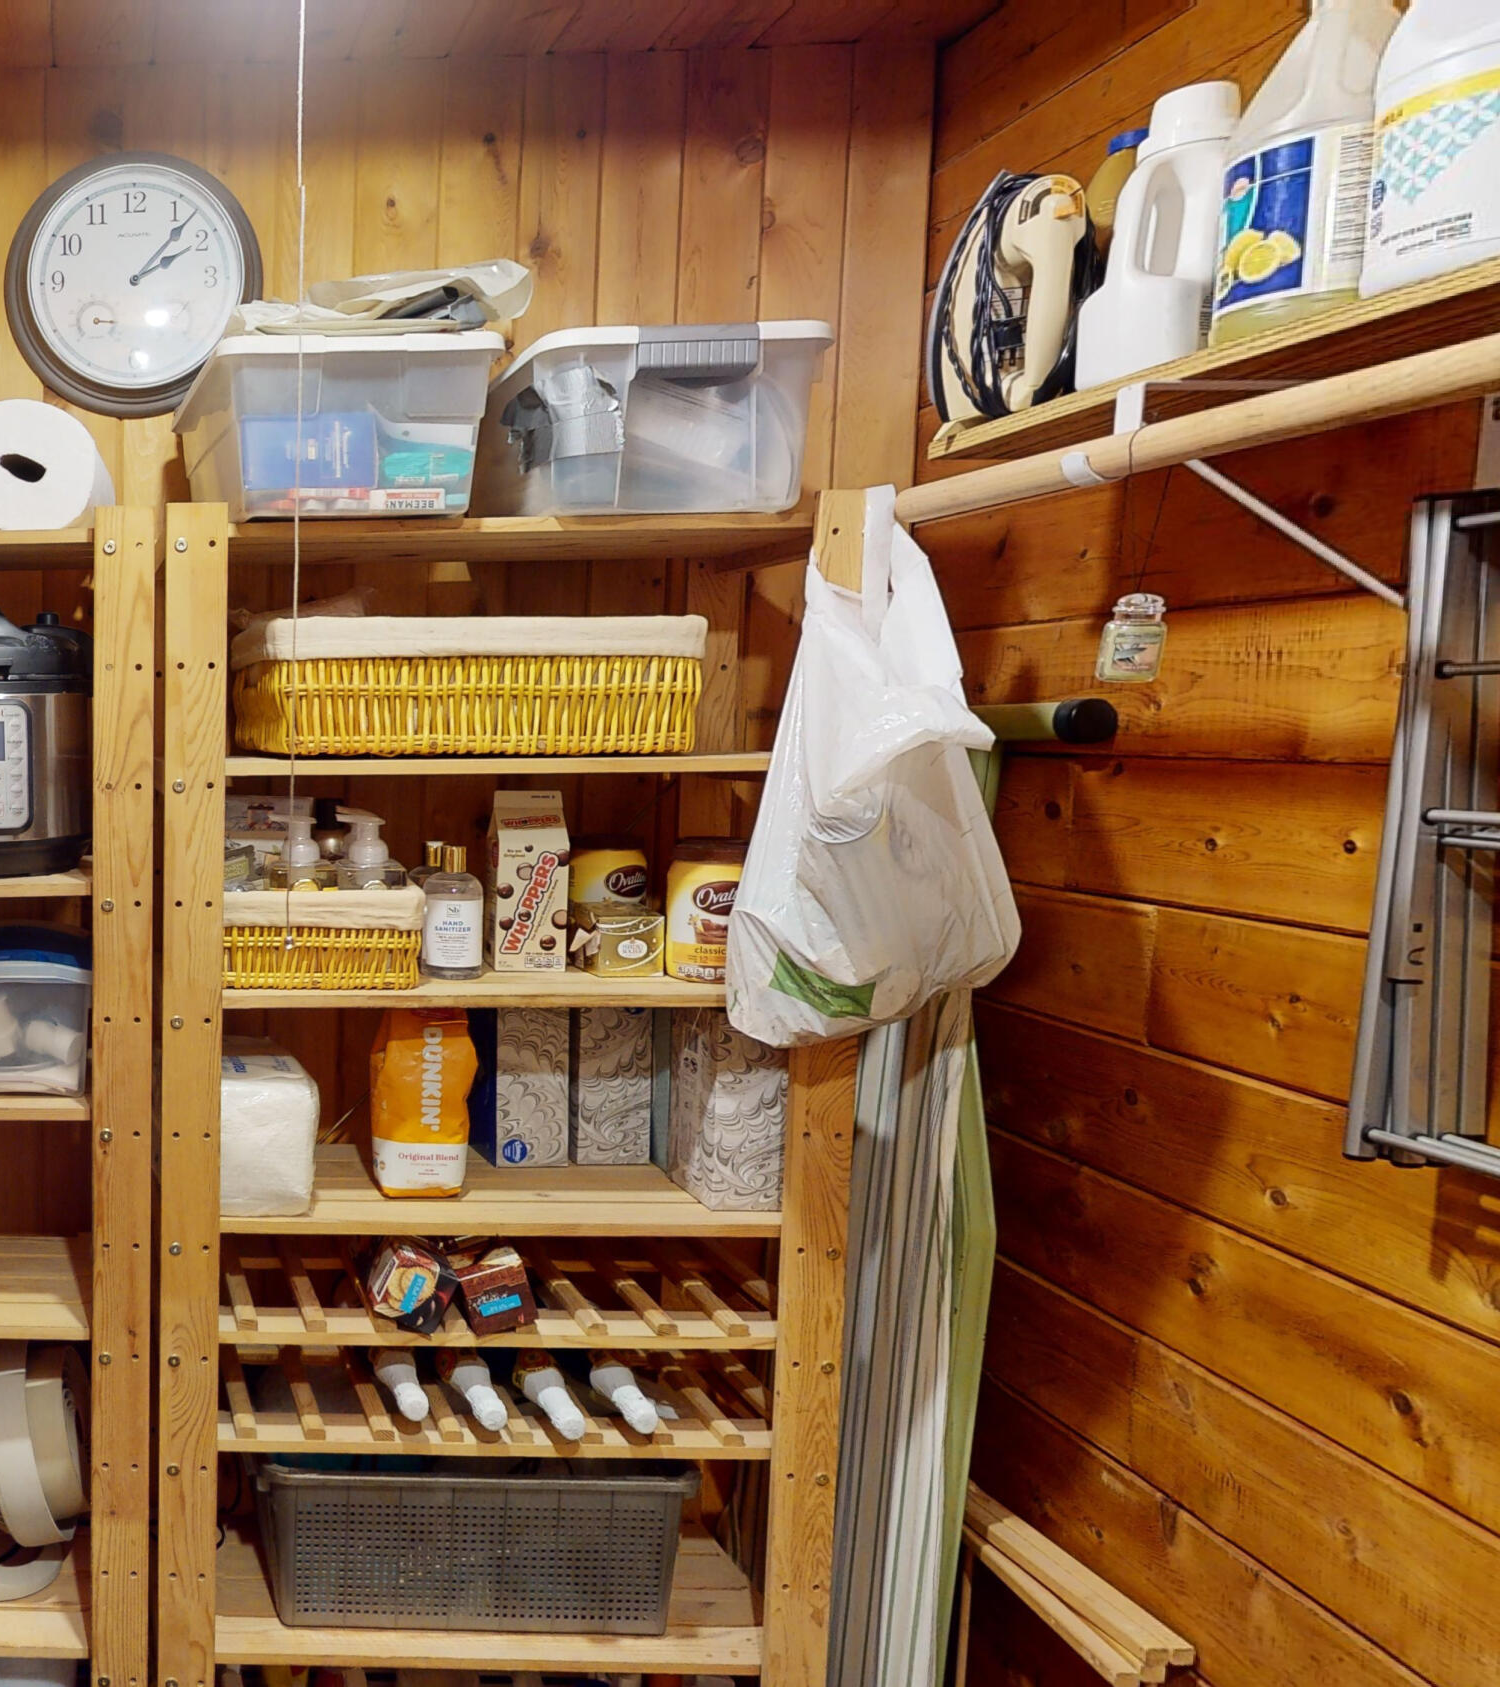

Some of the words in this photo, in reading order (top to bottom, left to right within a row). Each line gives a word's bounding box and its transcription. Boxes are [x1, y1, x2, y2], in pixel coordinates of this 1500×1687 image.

[122, 190, 147, 215] 12
[169, 200, 181, 223] 1
[86, 203, 108, 226] 11
[60, 232, 82, 257] 10
[195, 229, 209, 252] 2
[52, 270, 65, 294] 9
[204, 266, 218, 289] 3
[502, 815, 561, 828] WHOPPERS
[503, 852, 558, 953] WHOPPERS
[434, 925, 472, 933] SANITIZER
[694, 945, 727, 955] classic
[398, 1152, 434, 1162] Original
[436, 1152, 460, 1161] Blend
